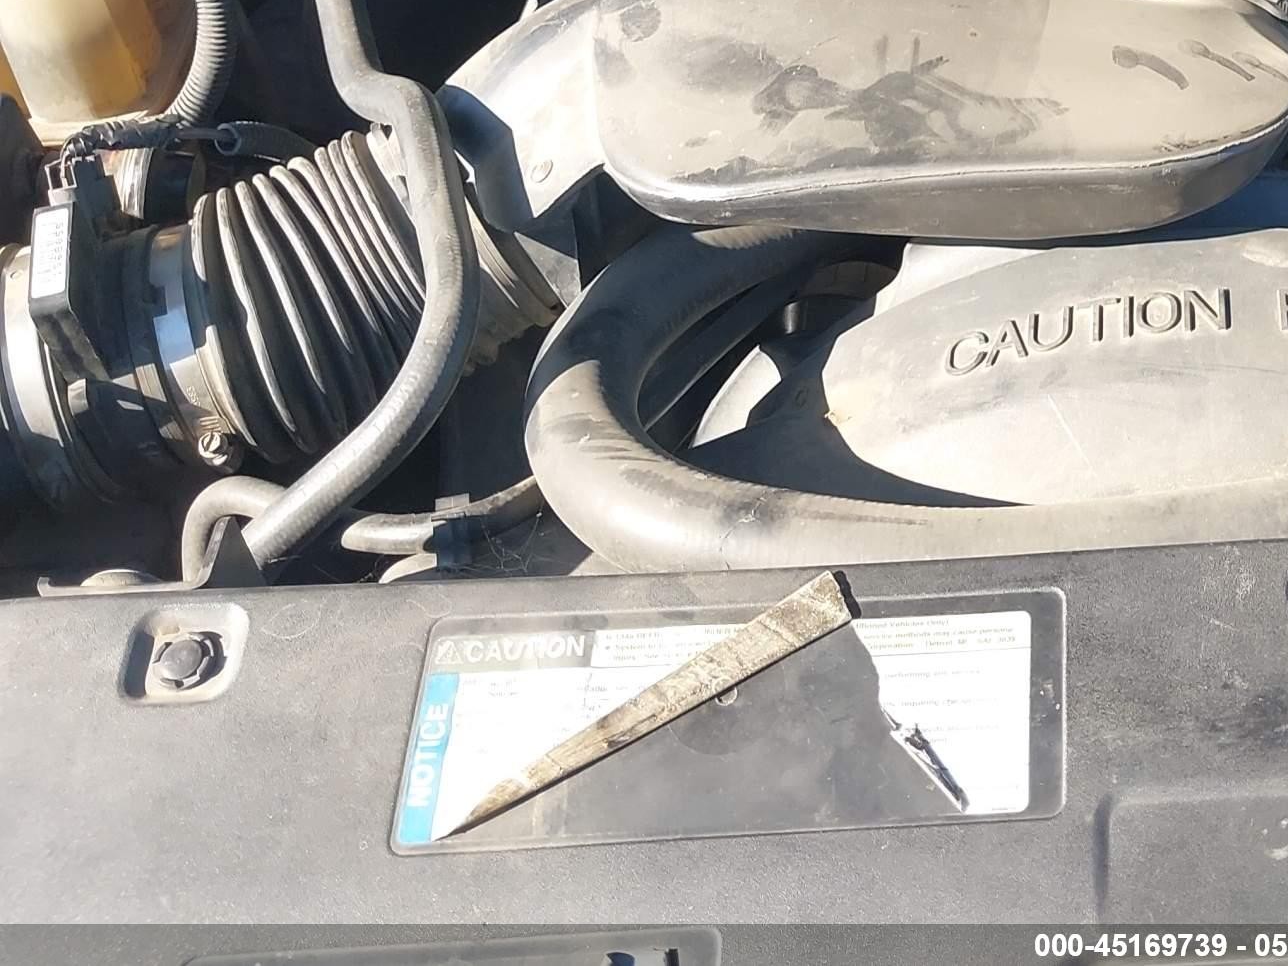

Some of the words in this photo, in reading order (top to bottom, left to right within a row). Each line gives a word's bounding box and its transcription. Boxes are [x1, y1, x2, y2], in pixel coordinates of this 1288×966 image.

[943, 287, 1231, 376] CAUTION
[465, 635, 585, 663] CAUTION
[407, 703, 449, 807] NOTICE
